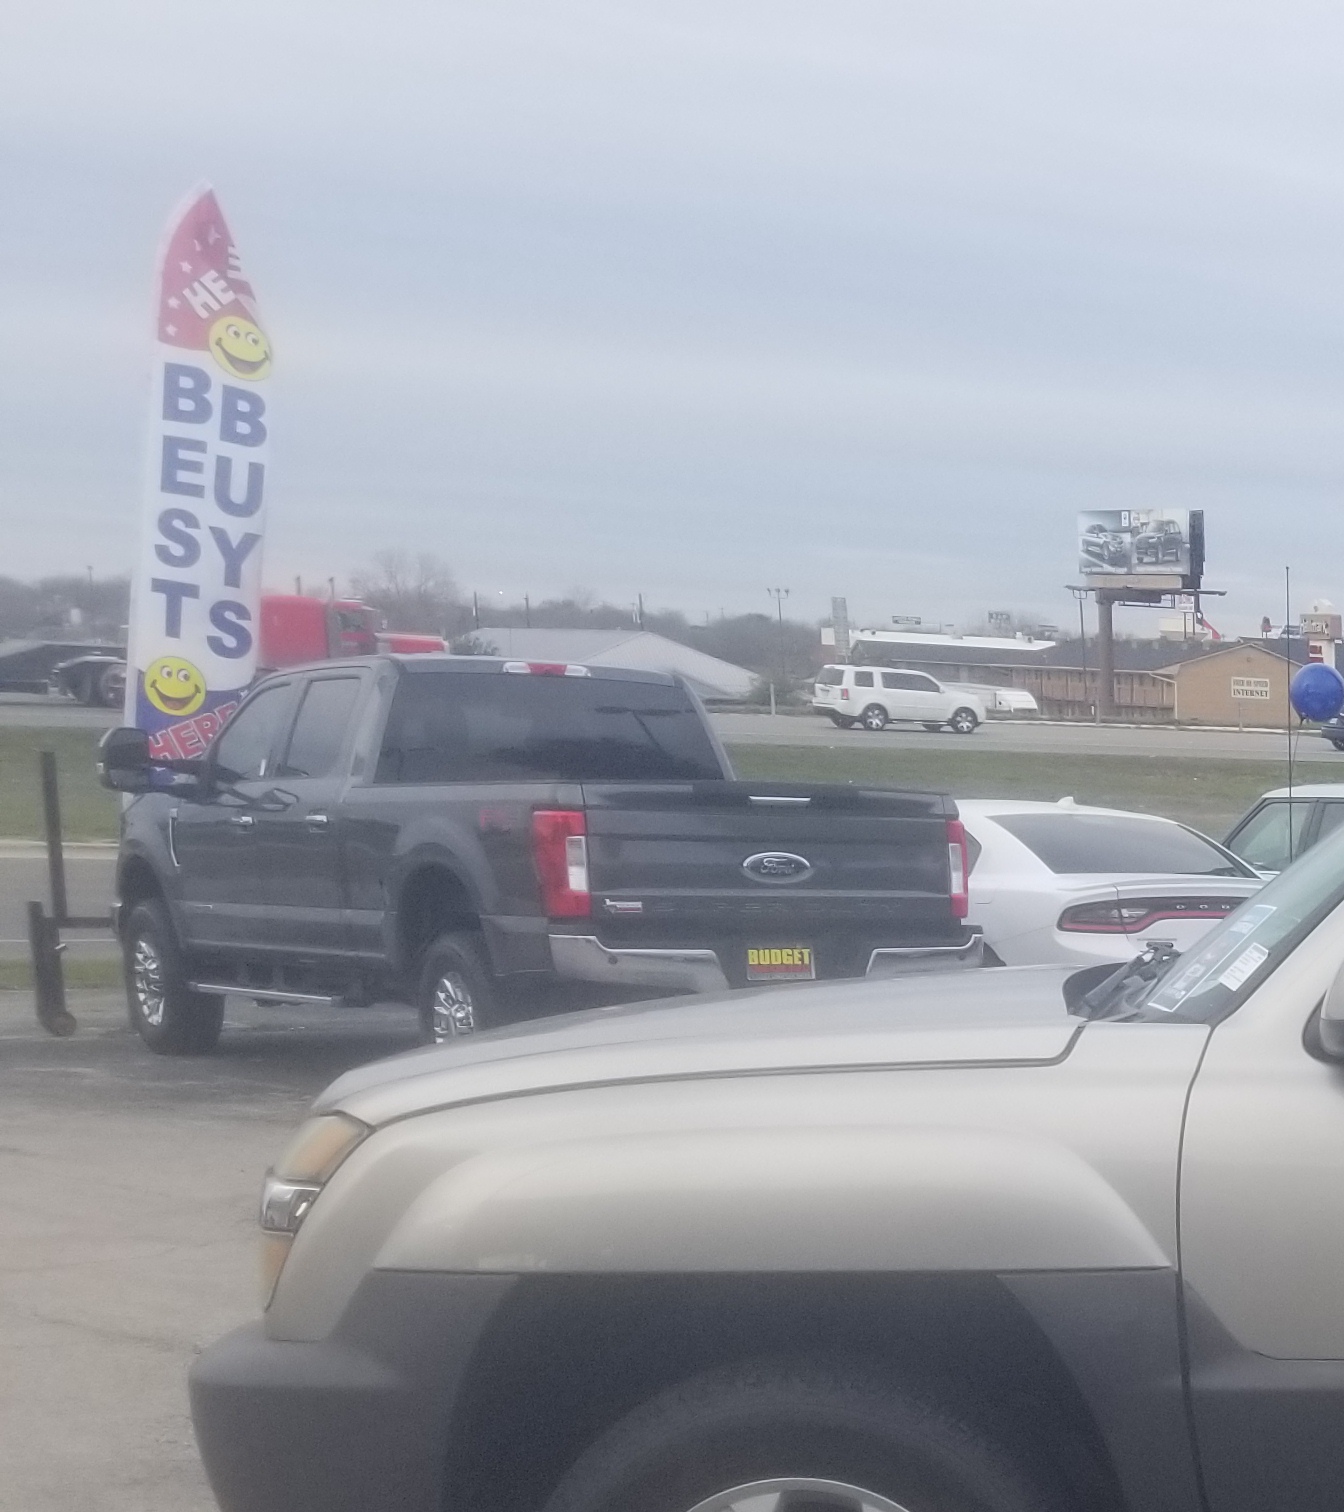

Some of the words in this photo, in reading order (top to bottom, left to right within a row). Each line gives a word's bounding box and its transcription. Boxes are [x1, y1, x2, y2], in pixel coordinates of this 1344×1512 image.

[151, 361, 213, 639] BEST
[206, 384, 268, 660] BUYS
[1233, 688, 1268, 697] INTERNET
[748, 948, 810, 965] BUDGET
